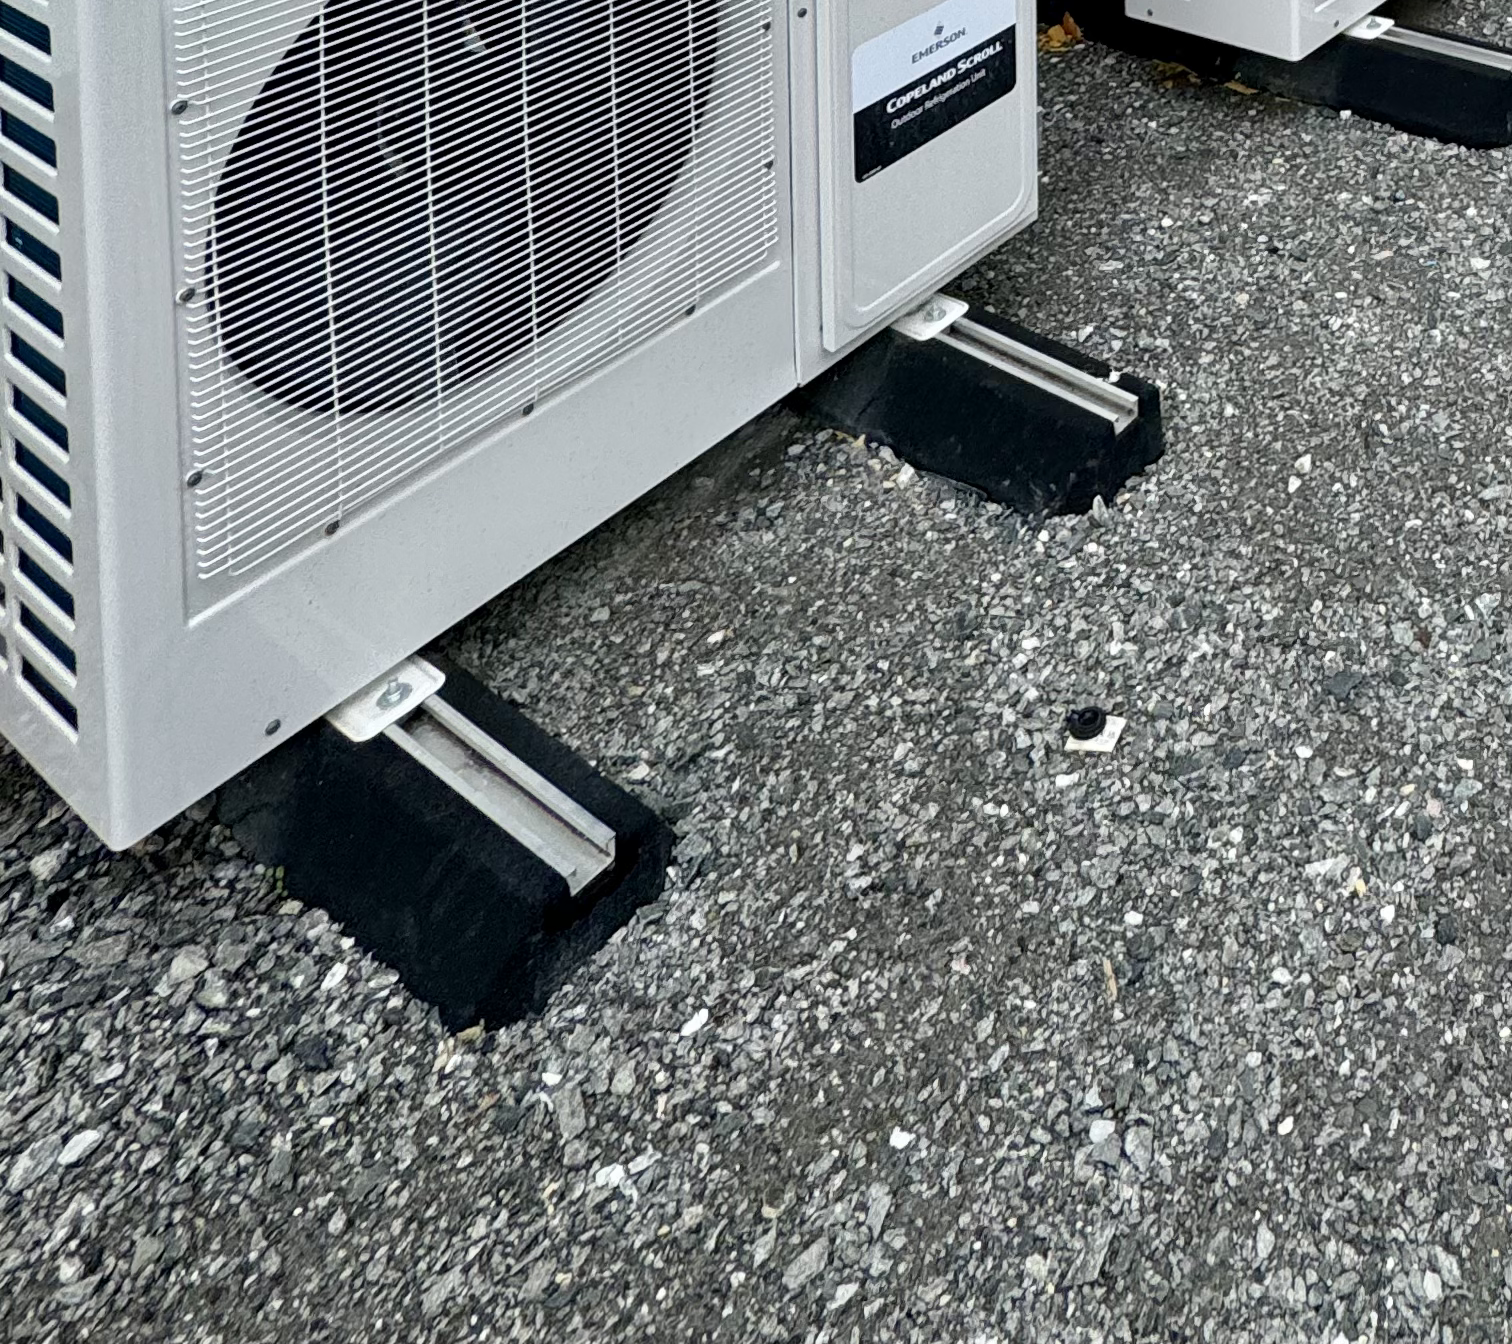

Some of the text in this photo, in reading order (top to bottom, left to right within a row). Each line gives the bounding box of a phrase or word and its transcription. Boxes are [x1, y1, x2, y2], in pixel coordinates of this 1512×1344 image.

[912, 26, 966, 64] EMERSON
[886, 41, 1004, 114] COPELAND SCROLL
[891, 68, 986, 129] Outdoor Refrigeration Unit
